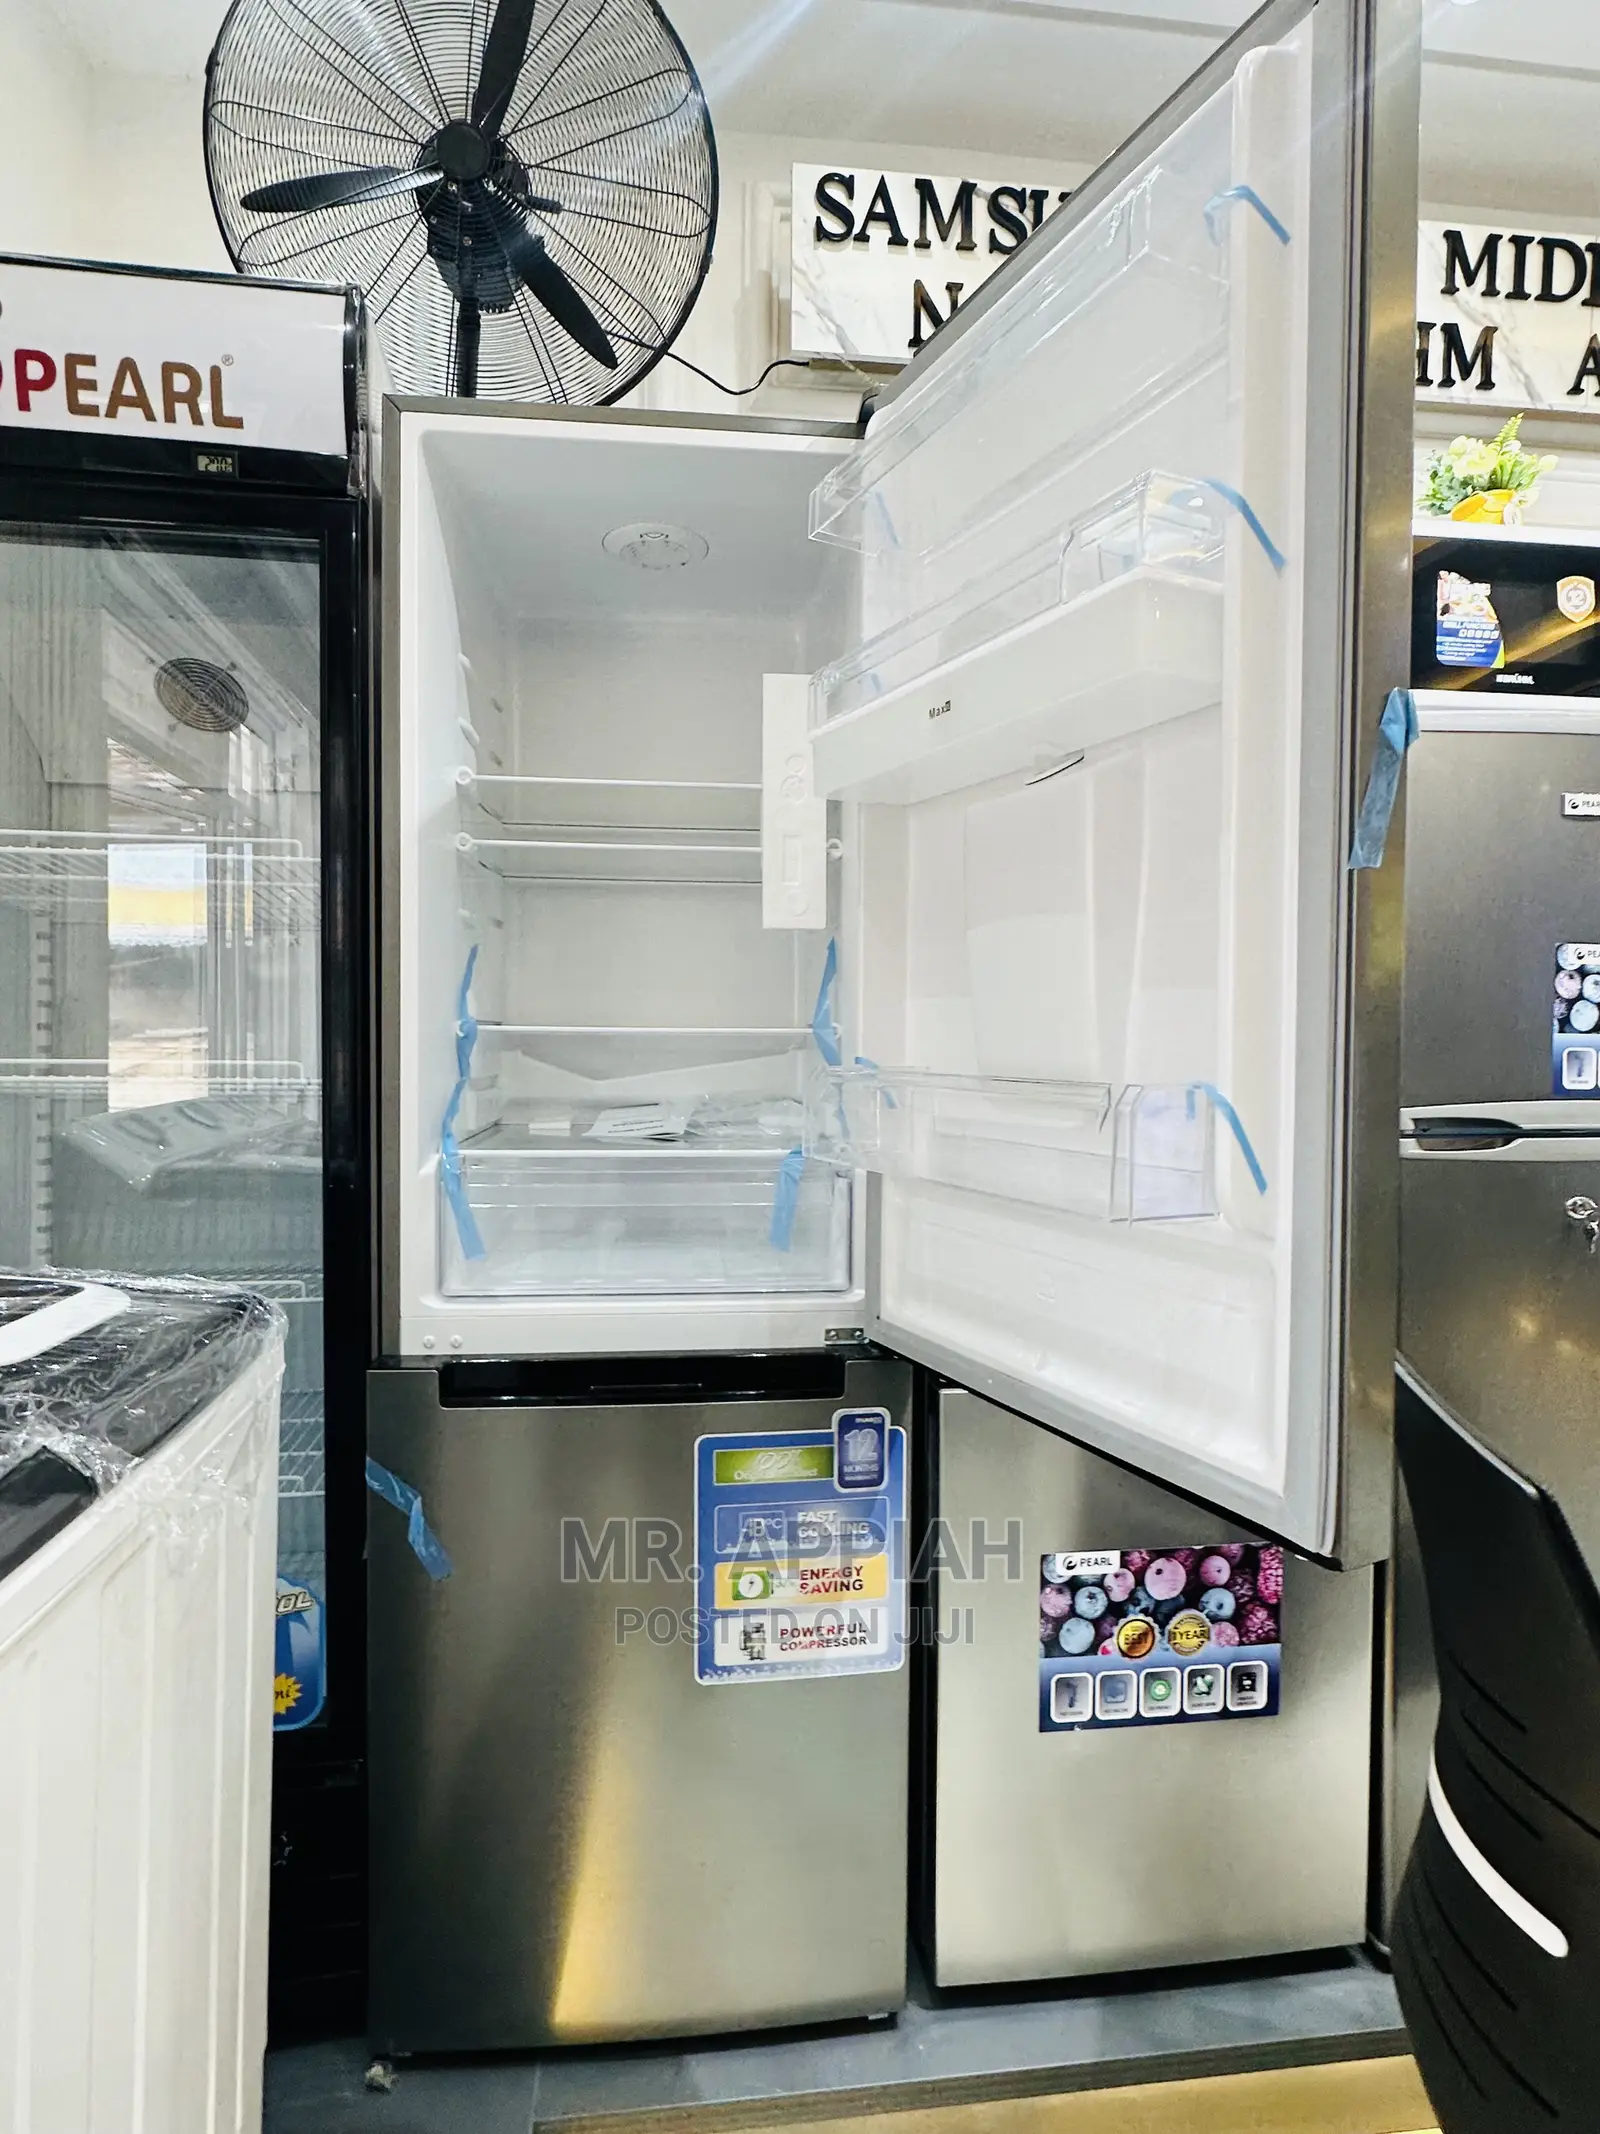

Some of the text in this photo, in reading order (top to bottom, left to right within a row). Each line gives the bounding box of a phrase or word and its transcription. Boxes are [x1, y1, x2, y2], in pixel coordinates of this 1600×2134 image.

[844, 1428, 879, 1461] 12
[797, 1510, 837, 1524] FAST
[797, 1522, 869, 1539] COOLING
[1079, 1556, 1113, 1568] PEARL
[800, 1566, 863, 1580] ENERGY
[800, 1579, 863, 1594] SAVING
[780, 1623, 867, 1639] POWERFUL
[780, 1637, 867, 1651] COMPRESSOR
